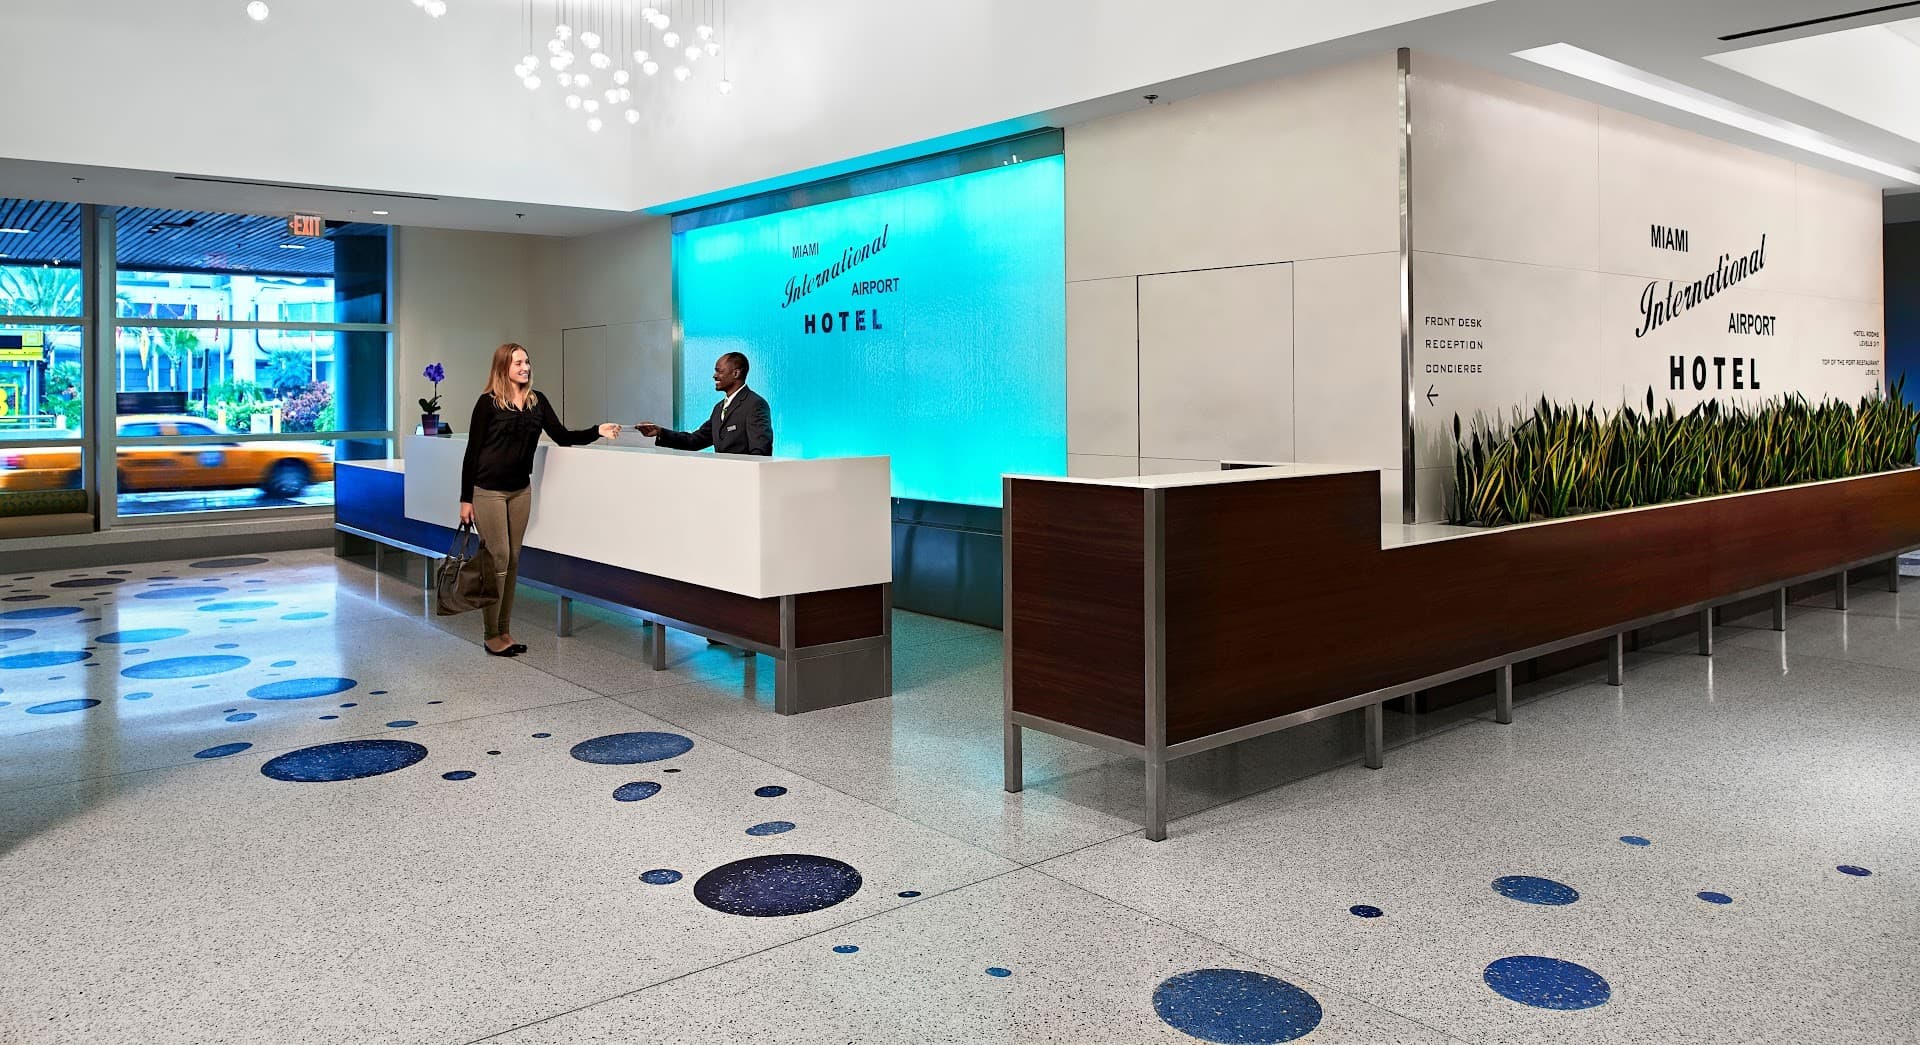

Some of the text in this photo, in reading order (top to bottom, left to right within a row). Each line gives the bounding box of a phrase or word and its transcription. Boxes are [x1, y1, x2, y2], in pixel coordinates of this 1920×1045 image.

[294, 215, 321, 237] EXIT
[1651, 224, 1689, 253] MIAMI
[792, 242, 819, 259] MIAMI
[781, 223, 889, 309] International
[852, 277, 900, 297] AIRPORT
[1635, 233, 1766, 338] International
[804, 308, 883, 335] HOTEL
[1425, 316, 1482, 328] FRONT DESK
[1728, 312, 1776, 337] AIRPORT
[1425, 339, 1483, 350] RECEPTION
[1425, 364, 1483, 373] CONCIERGE
[1670, 355, 1761, 391] HOTEL
